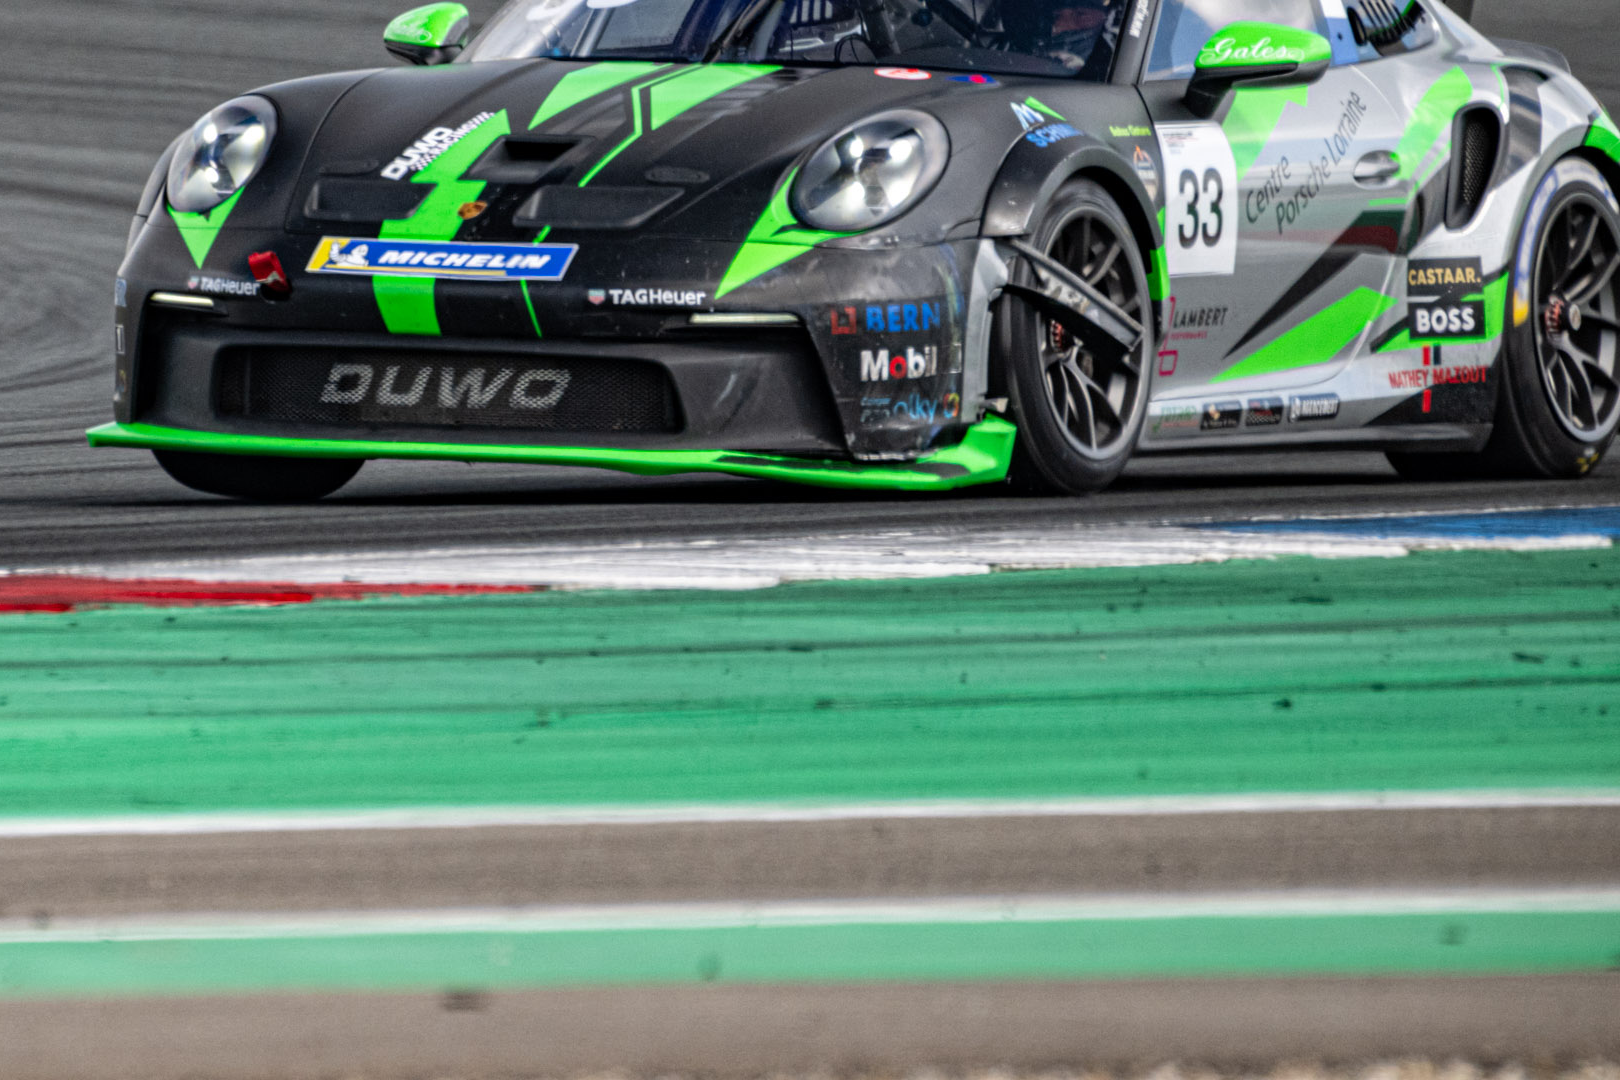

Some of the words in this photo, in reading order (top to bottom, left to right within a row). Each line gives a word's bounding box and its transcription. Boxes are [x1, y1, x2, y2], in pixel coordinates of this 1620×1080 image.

[380, 126, 454, 180] DUWO
[1276, 154, 1332, 235] Porsche
[1324, 91, 1368, 166] Lorraine
[1179, 167, 1225, 250] 33
[1246, 155, 1292, 224] Centre
[377, 249, 551, 270] MICHELIN
[1174, 307, 1228, 329] LAMBERT
[1415, 307, 1475, 333] BOSS
[860, 345, 938, 382] Mobil
[1388, 369, 1429, 389] MATHEY
[1433, 365, 1488, 386] MAZOUT
[318, 363, 572, 409] DUWO
